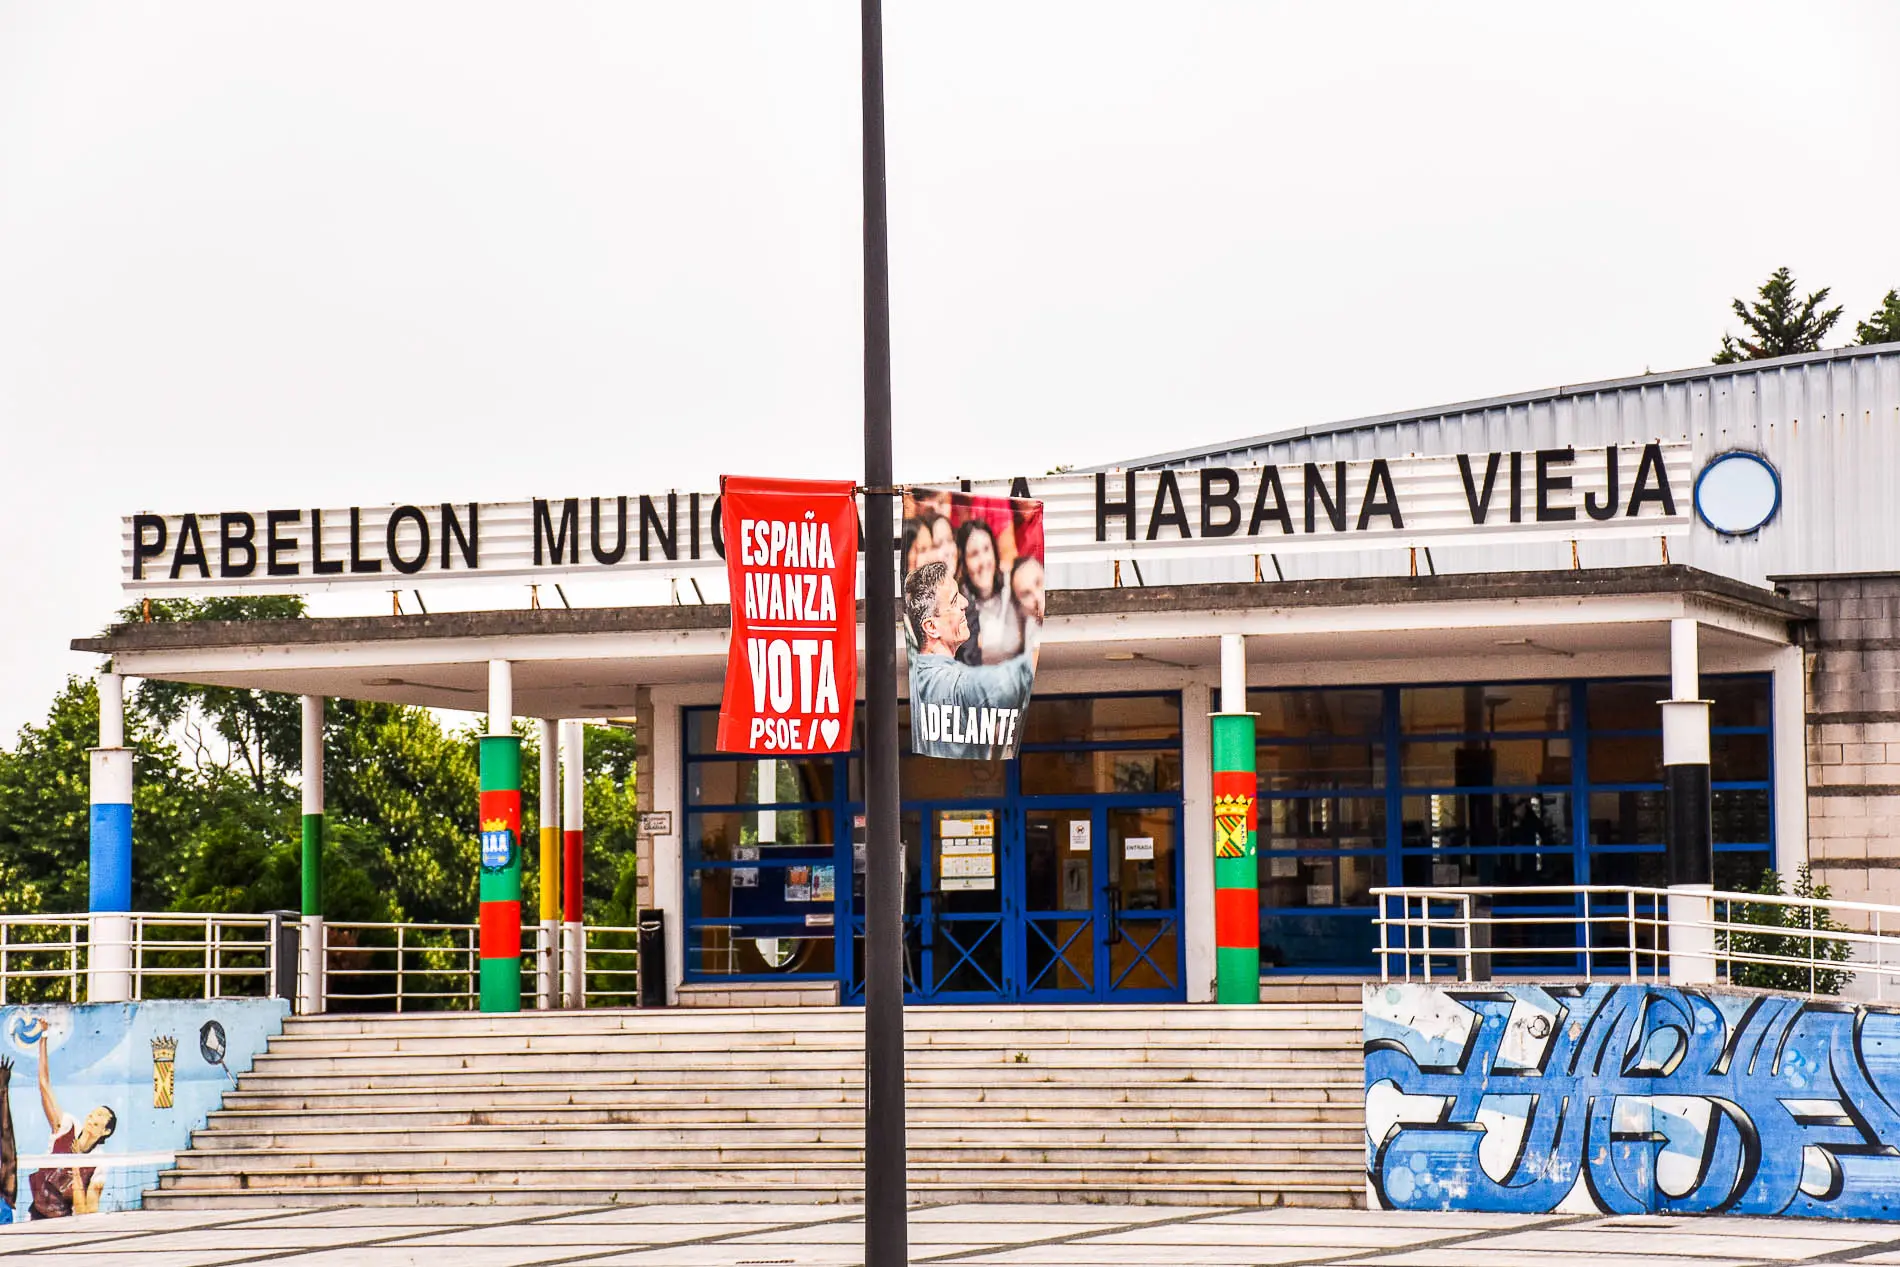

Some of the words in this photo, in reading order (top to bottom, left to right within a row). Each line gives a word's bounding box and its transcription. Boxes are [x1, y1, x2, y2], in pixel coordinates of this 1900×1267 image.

[132, 502, 479, 580] PABELLON
[1095, 458, 1405, 542] HABANA
[1456, 443, 1677, 525] VIEJA
[740, 510, 836, 569] ESPAÑA
[745, 572, 837, 622] AVANZA
[747, 637, 840, 714] VOTA
[749, 717, 802, 750] PSOE
[920, 702, 1019, 746] ADELANTE
